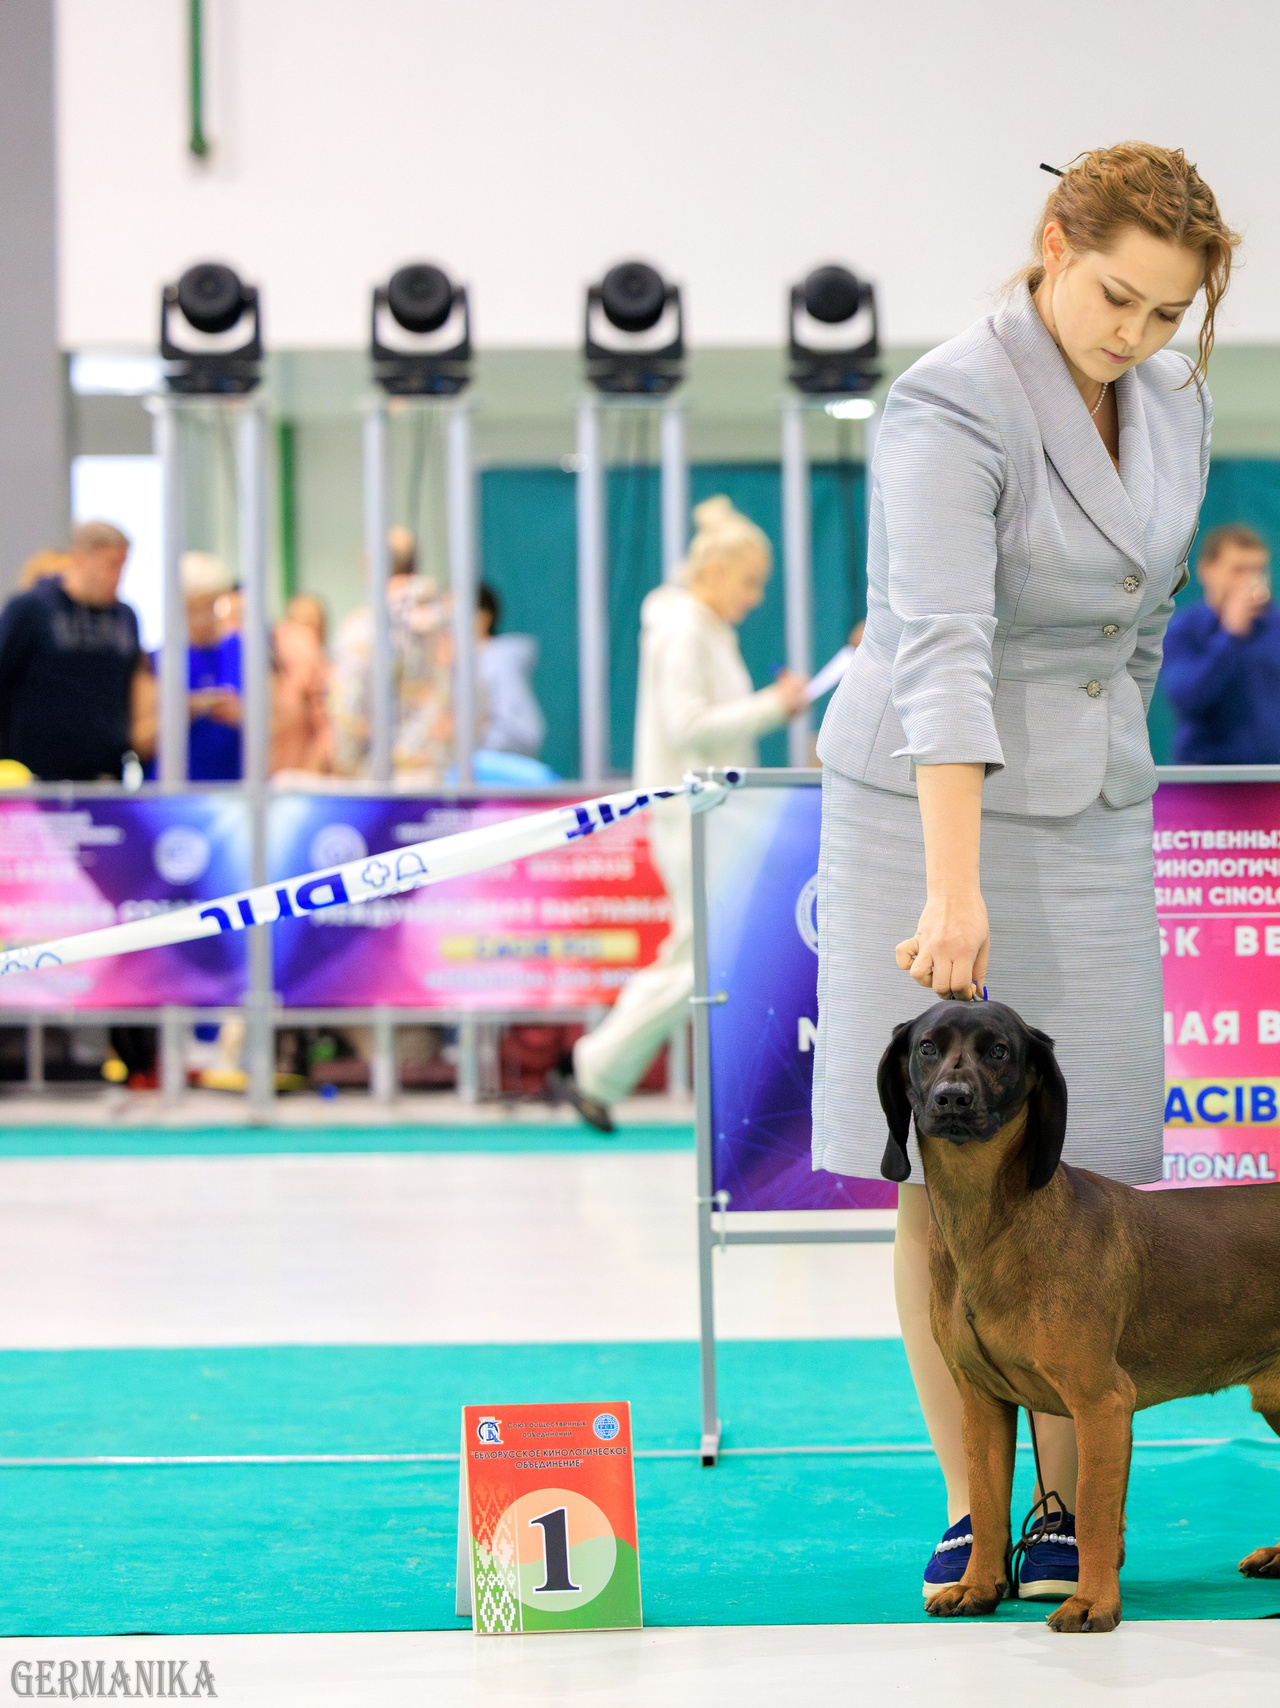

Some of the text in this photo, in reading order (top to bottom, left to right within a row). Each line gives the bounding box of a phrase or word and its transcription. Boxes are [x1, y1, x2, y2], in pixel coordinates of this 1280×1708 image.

[1164, 1085, 1278, 1123] ACIB
[1162, 1152, 1276, 1180] TIONAL
[543, 1447, 628, 1458] КИНОЛОГИЧЕСКОЕ
[529, 1506, 582, 1594] 1
